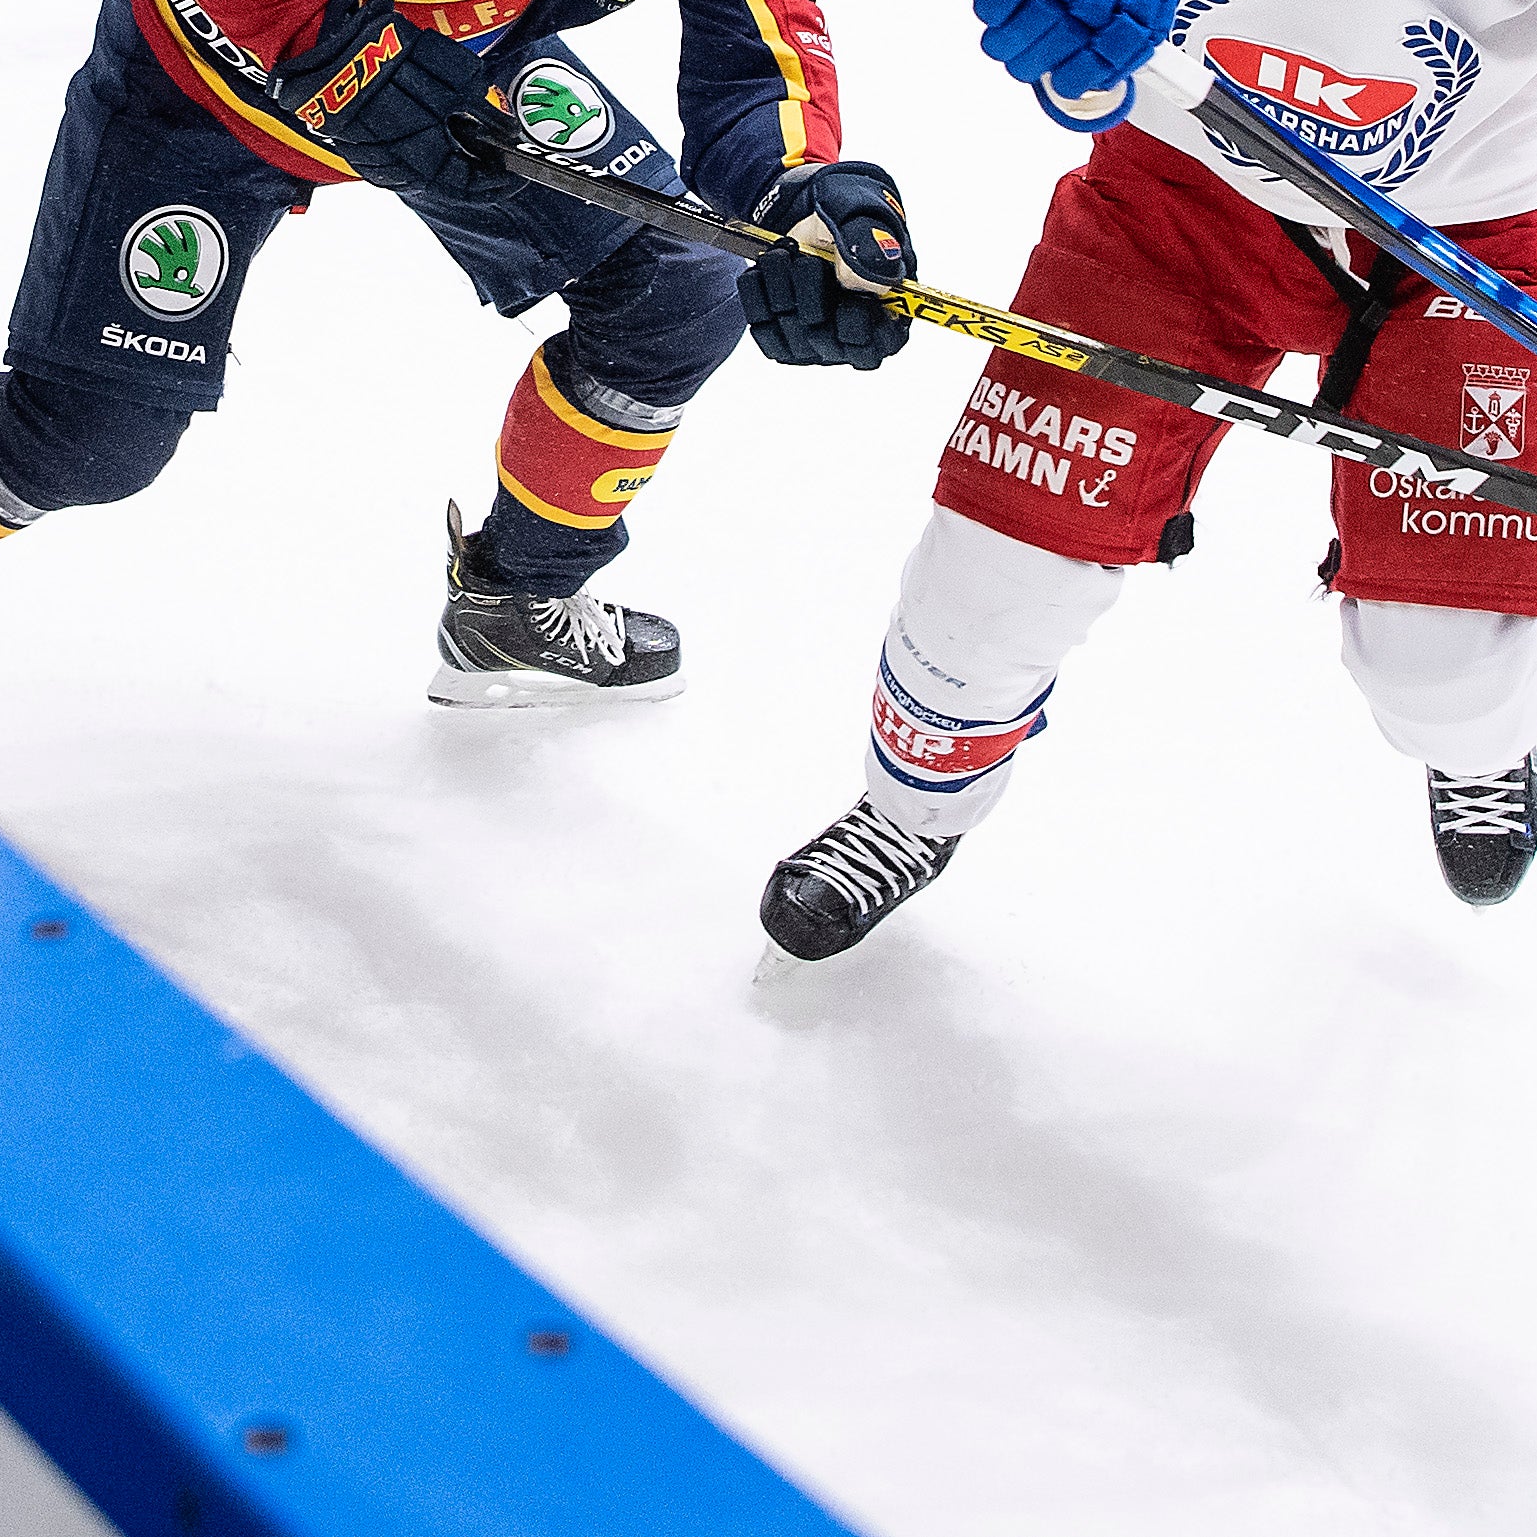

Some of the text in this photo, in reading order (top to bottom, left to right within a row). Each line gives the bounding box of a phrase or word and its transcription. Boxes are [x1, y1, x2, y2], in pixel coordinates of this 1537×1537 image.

[295, 21, 404, 131] CCM
[1257, 51, 1368, 122] IK
[100, 323, 207, 363] ŠKODA
[968, 375, 1139, 468] OSKARS
[1190, 383, 1490, 496] CCM
[540, 649, 593, 675] CCM
